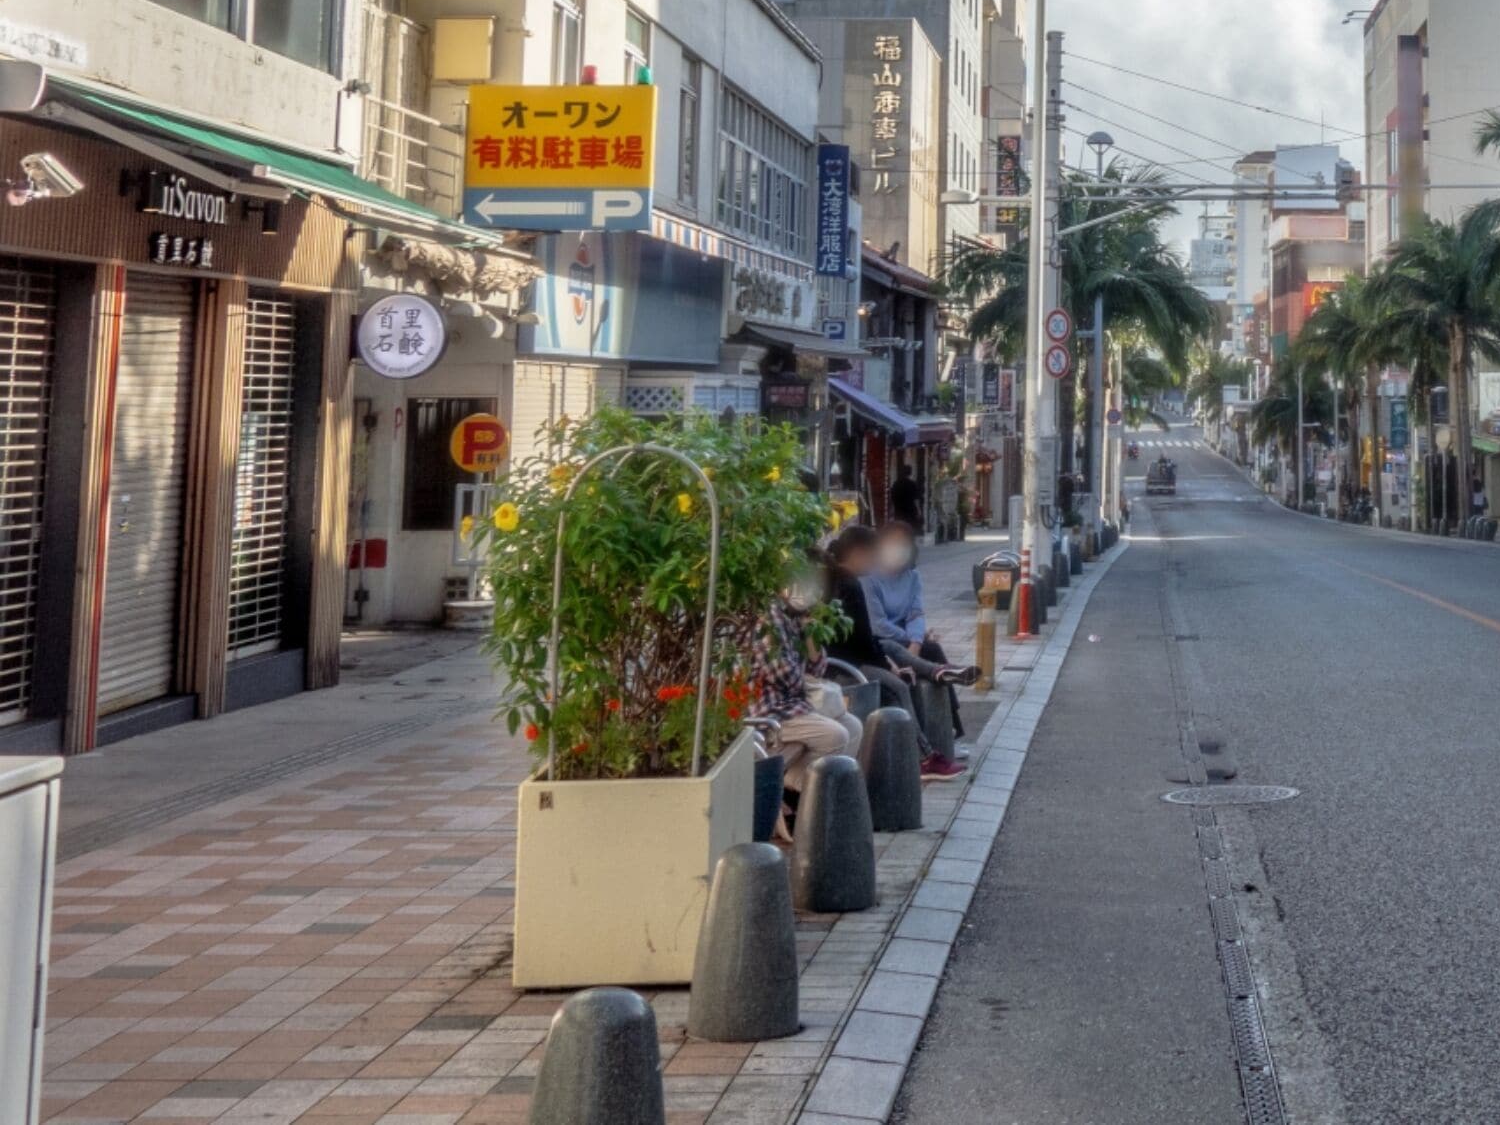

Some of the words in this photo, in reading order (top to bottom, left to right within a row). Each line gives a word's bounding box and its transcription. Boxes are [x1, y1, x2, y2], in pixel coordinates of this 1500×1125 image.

[502, 101, 622, 129] オーワン
[871, 35, 902, 195] 福山商事ビル
[472, 135, 645, 170] 有料駐車場
[592, 190, 643, 228] P
[818, 177, 845, 273] 大湾洋服店
[376, 307, 423, 331] 首里
[372, 332, 426, 356] 石鹸
[462, 422, 506, 465] P
